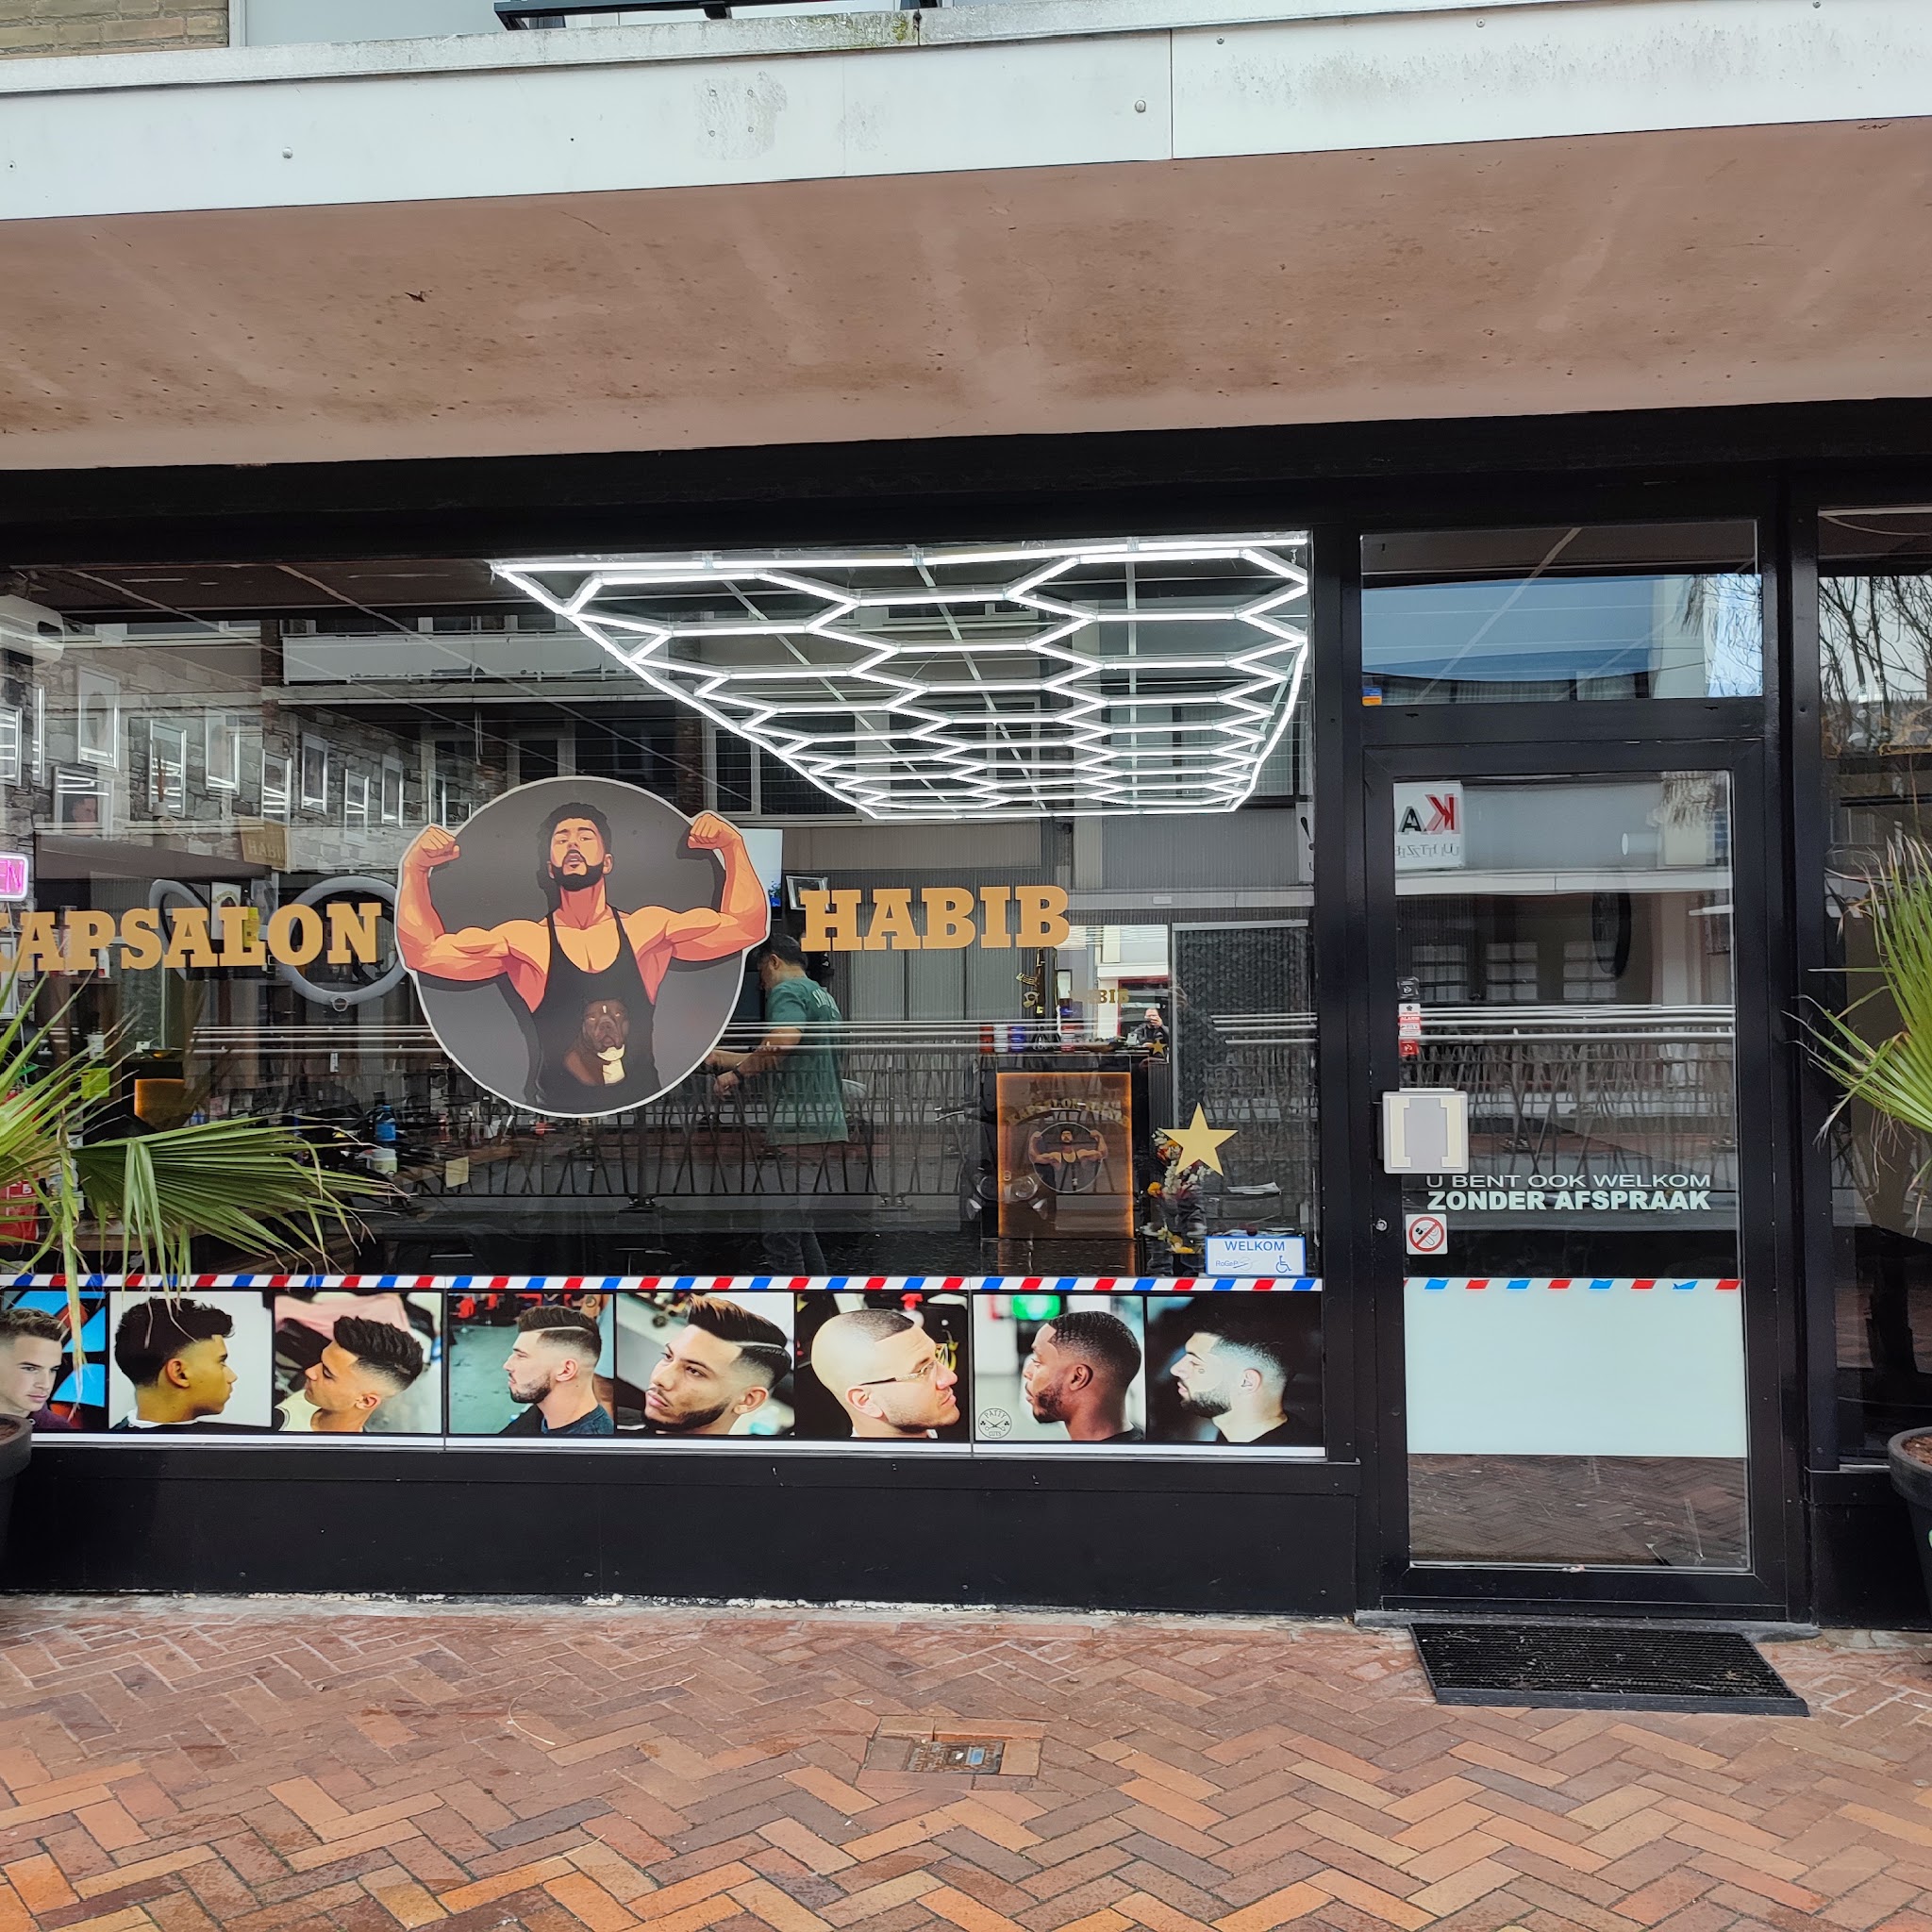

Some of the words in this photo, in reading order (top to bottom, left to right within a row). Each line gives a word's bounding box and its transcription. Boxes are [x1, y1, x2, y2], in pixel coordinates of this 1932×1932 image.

[800, 885, 1071, 953] HABIB
[1426, 1174, 1443, 1188] U
[1452, 1174, 1522, 1188] BENT
[1527, 1174, 1587, 1188] OOK
[1592, 1174, 1712, 1188] WELKOM
[1427, 1191, 1547, 1210] ZONDER
[1554, 1190, 1712, 1210] AFSPRAAK
[1224, 1241, 1285, 1251] WELKOM
